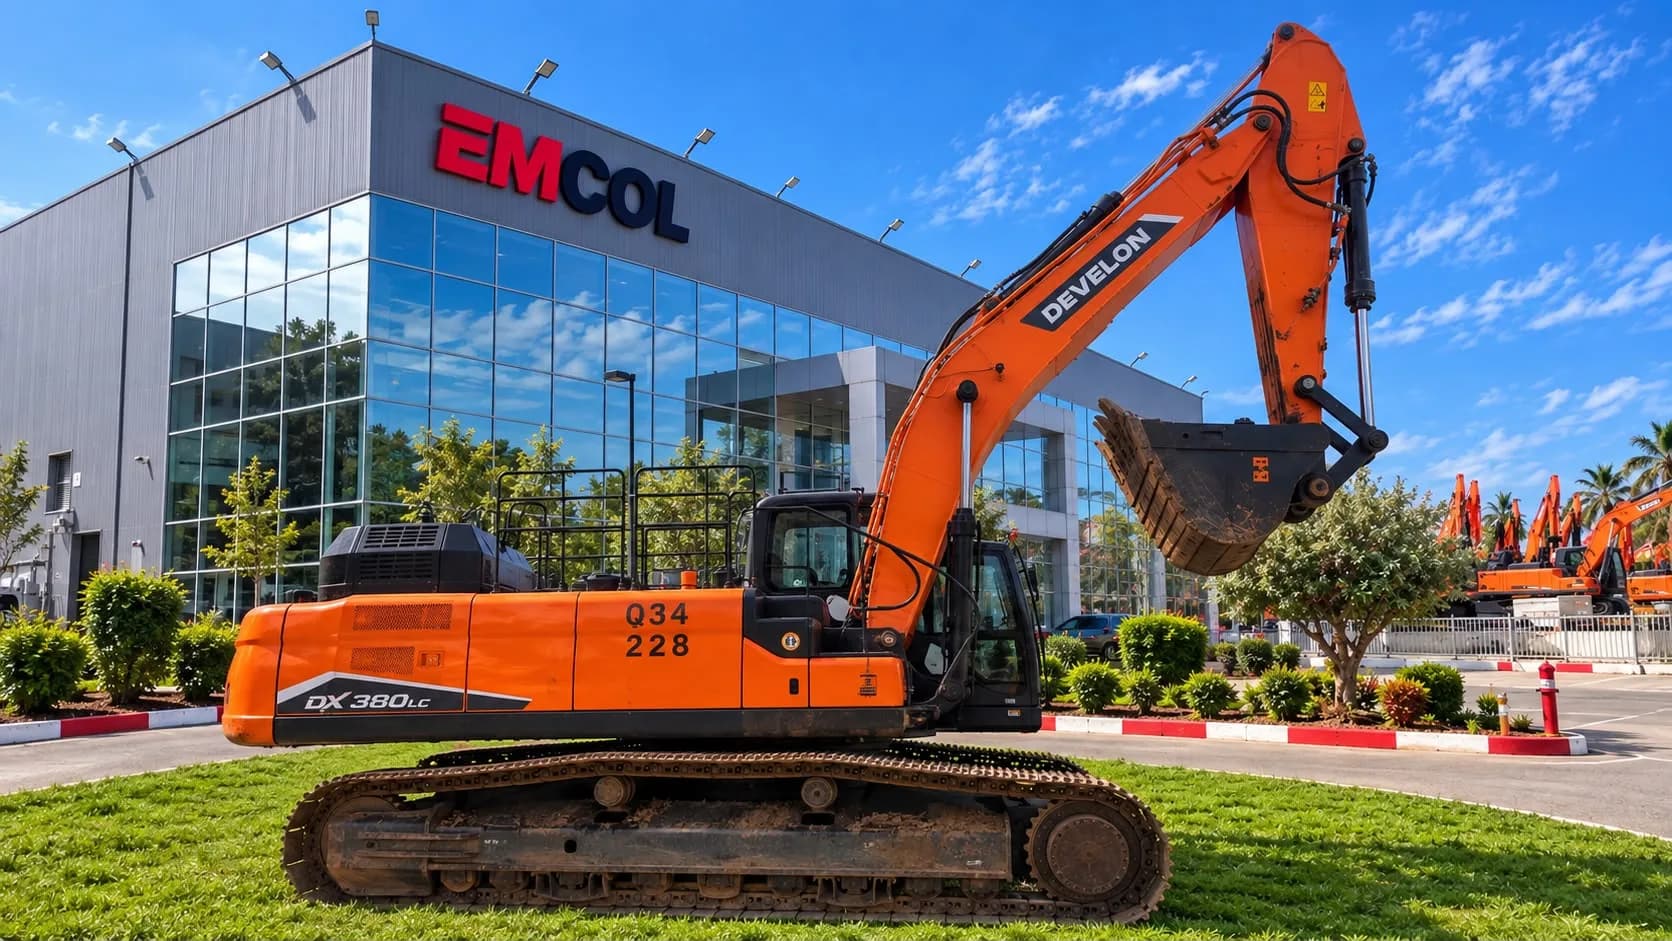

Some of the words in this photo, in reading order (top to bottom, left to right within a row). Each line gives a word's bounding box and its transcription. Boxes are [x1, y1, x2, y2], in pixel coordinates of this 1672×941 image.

[435, 102, 690, 244] EMCOL
[1041, 227, 1152, 324] DEVELON
[626, 602, 689, 628] Q34
[626, 633, 689, 657] 228
[304, 691, 353, 710] DX
